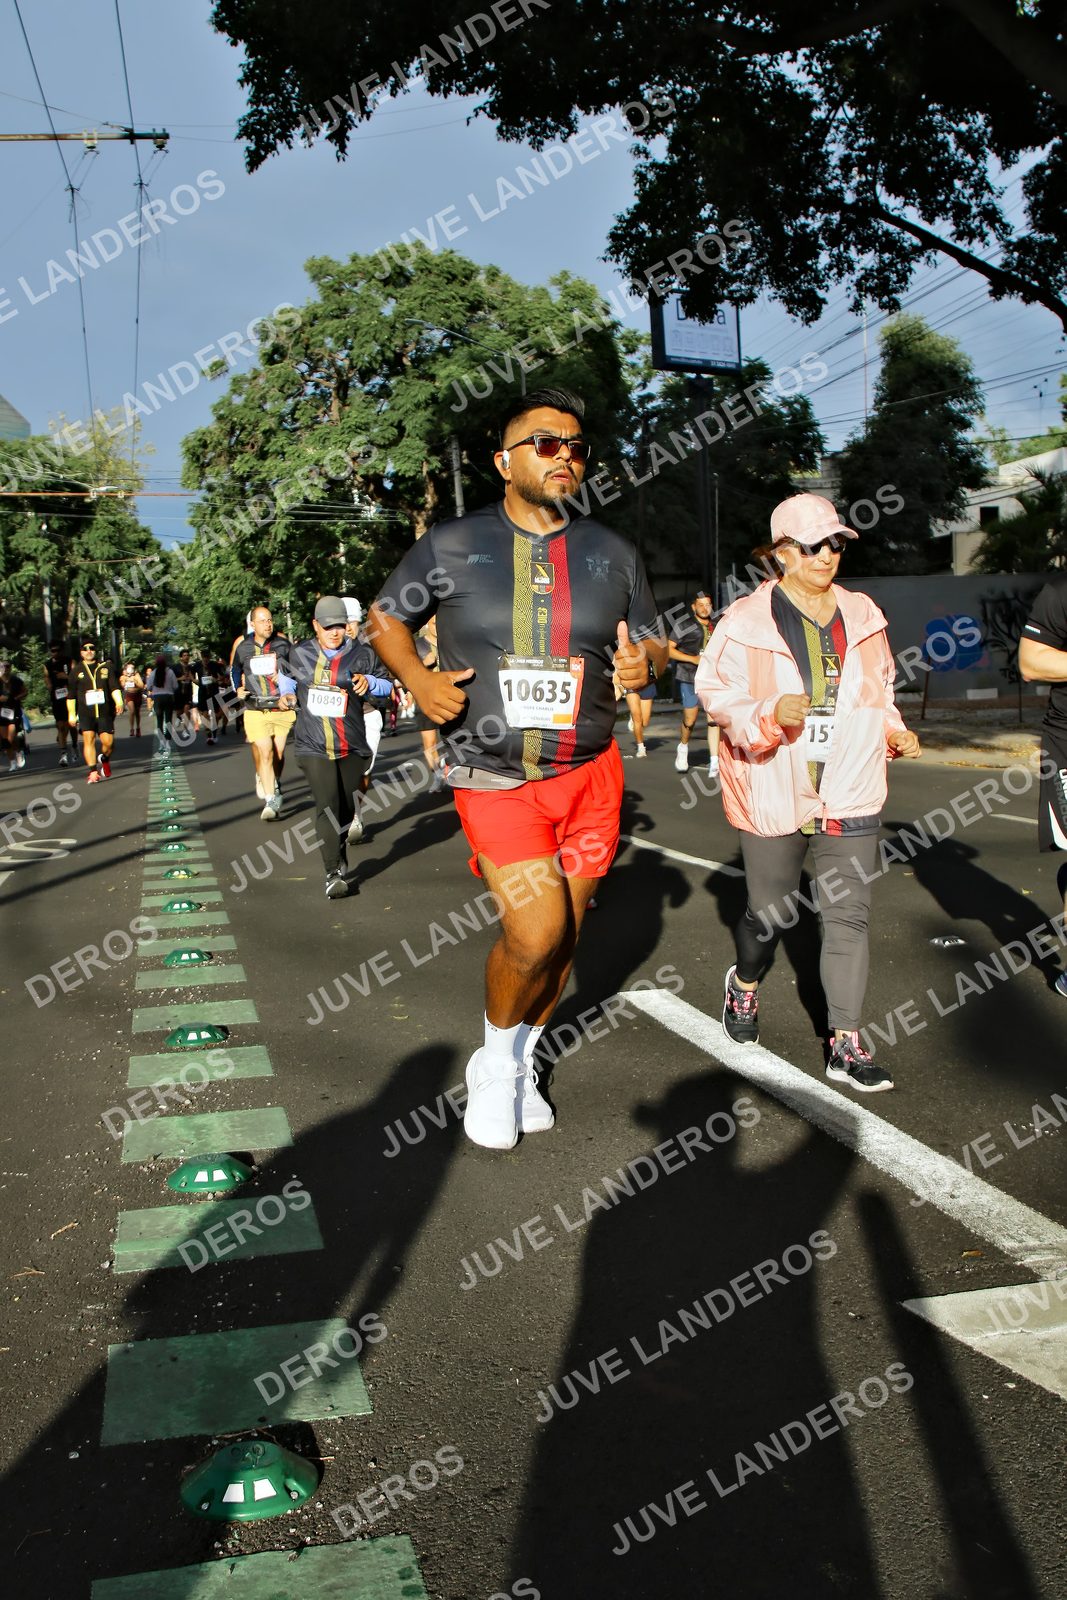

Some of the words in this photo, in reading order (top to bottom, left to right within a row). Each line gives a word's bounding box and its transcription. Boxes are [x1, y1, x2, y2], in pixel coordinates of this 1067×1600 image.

[311, 692, 343, 707] 10849
[503, 678, 572, 704] 10635
[807, 723, 835, 743] 15
